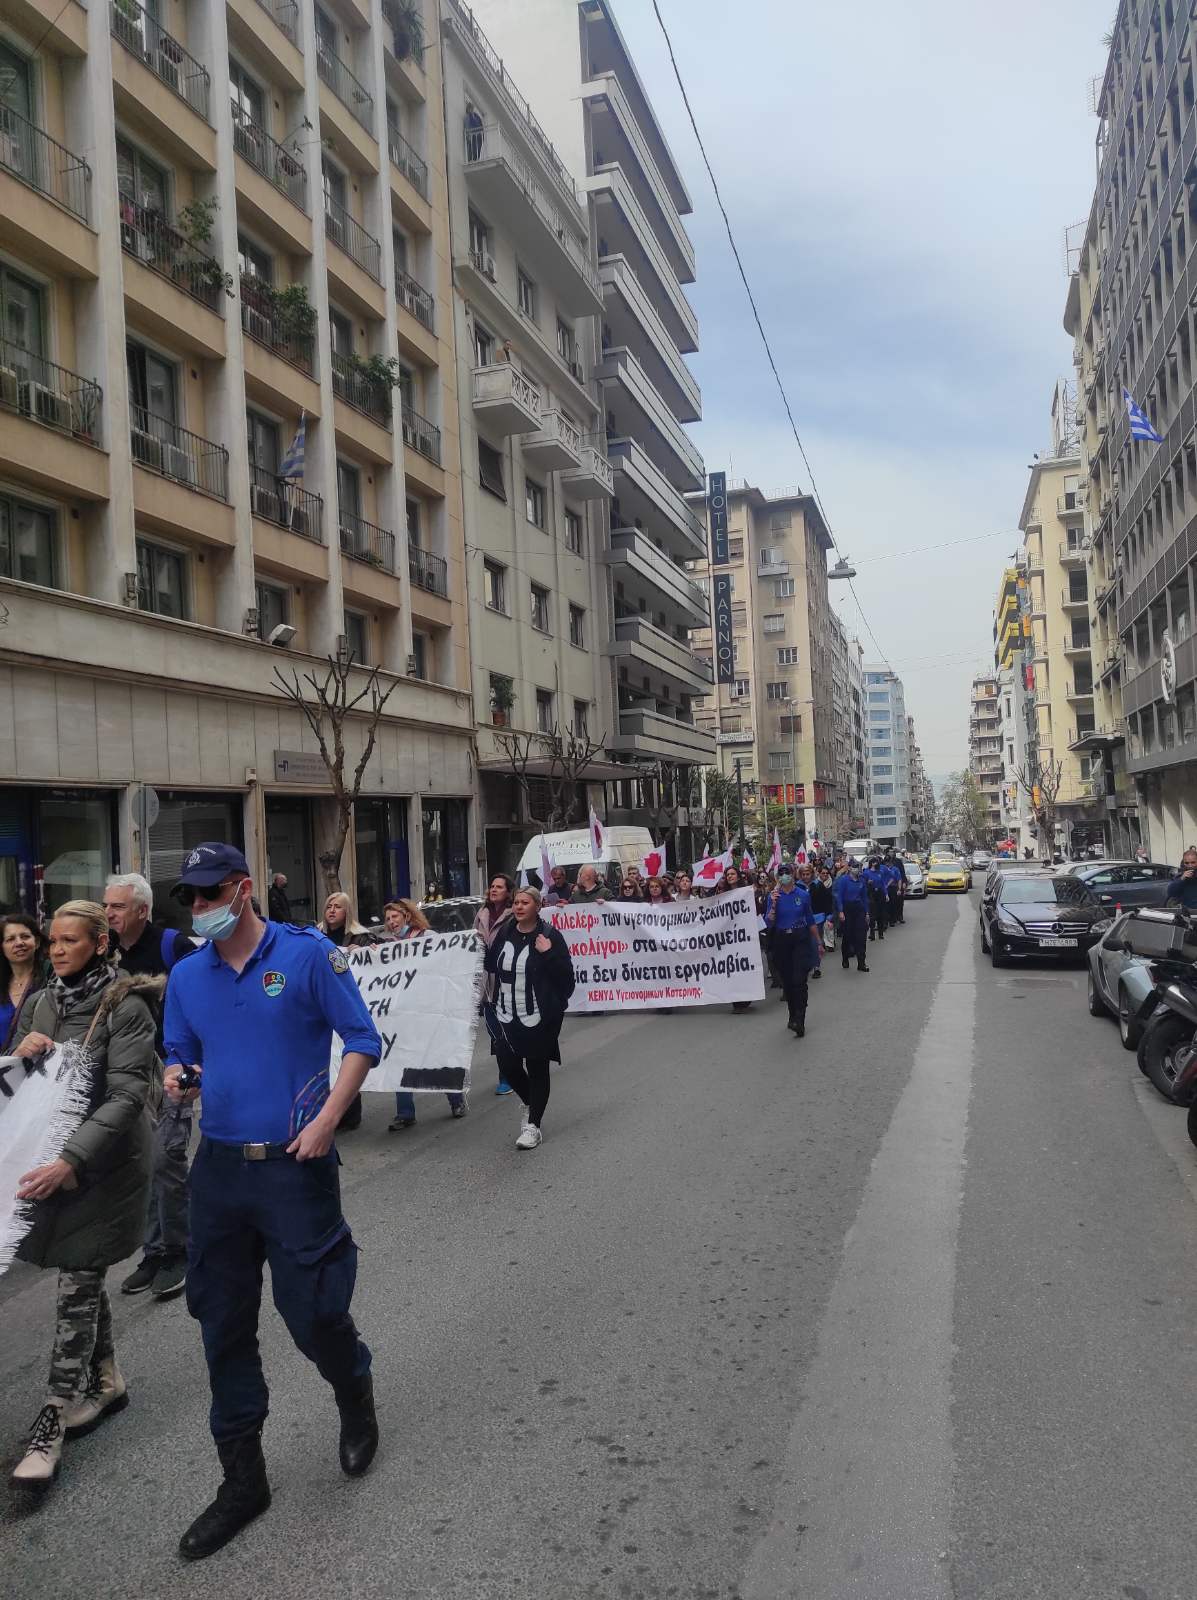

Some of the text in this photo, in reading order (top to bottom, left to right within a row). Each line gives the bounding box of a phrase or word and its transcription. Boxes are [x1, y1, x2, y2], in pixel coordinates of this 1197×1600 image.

[712, 479, 731, 676] HOTEL PARNON
[602, 912, 621, 928] των
[624, 907, 698, 931] υγειονομικών
[633, 939, 657, 953] στα
[661, 923, 751, 952] νοσοκομεία.
[593, 965, 618, 983] δεν
[622, 962, 671, 982] δίνεται
[675, 952, 755, 983] εργολαβία.
